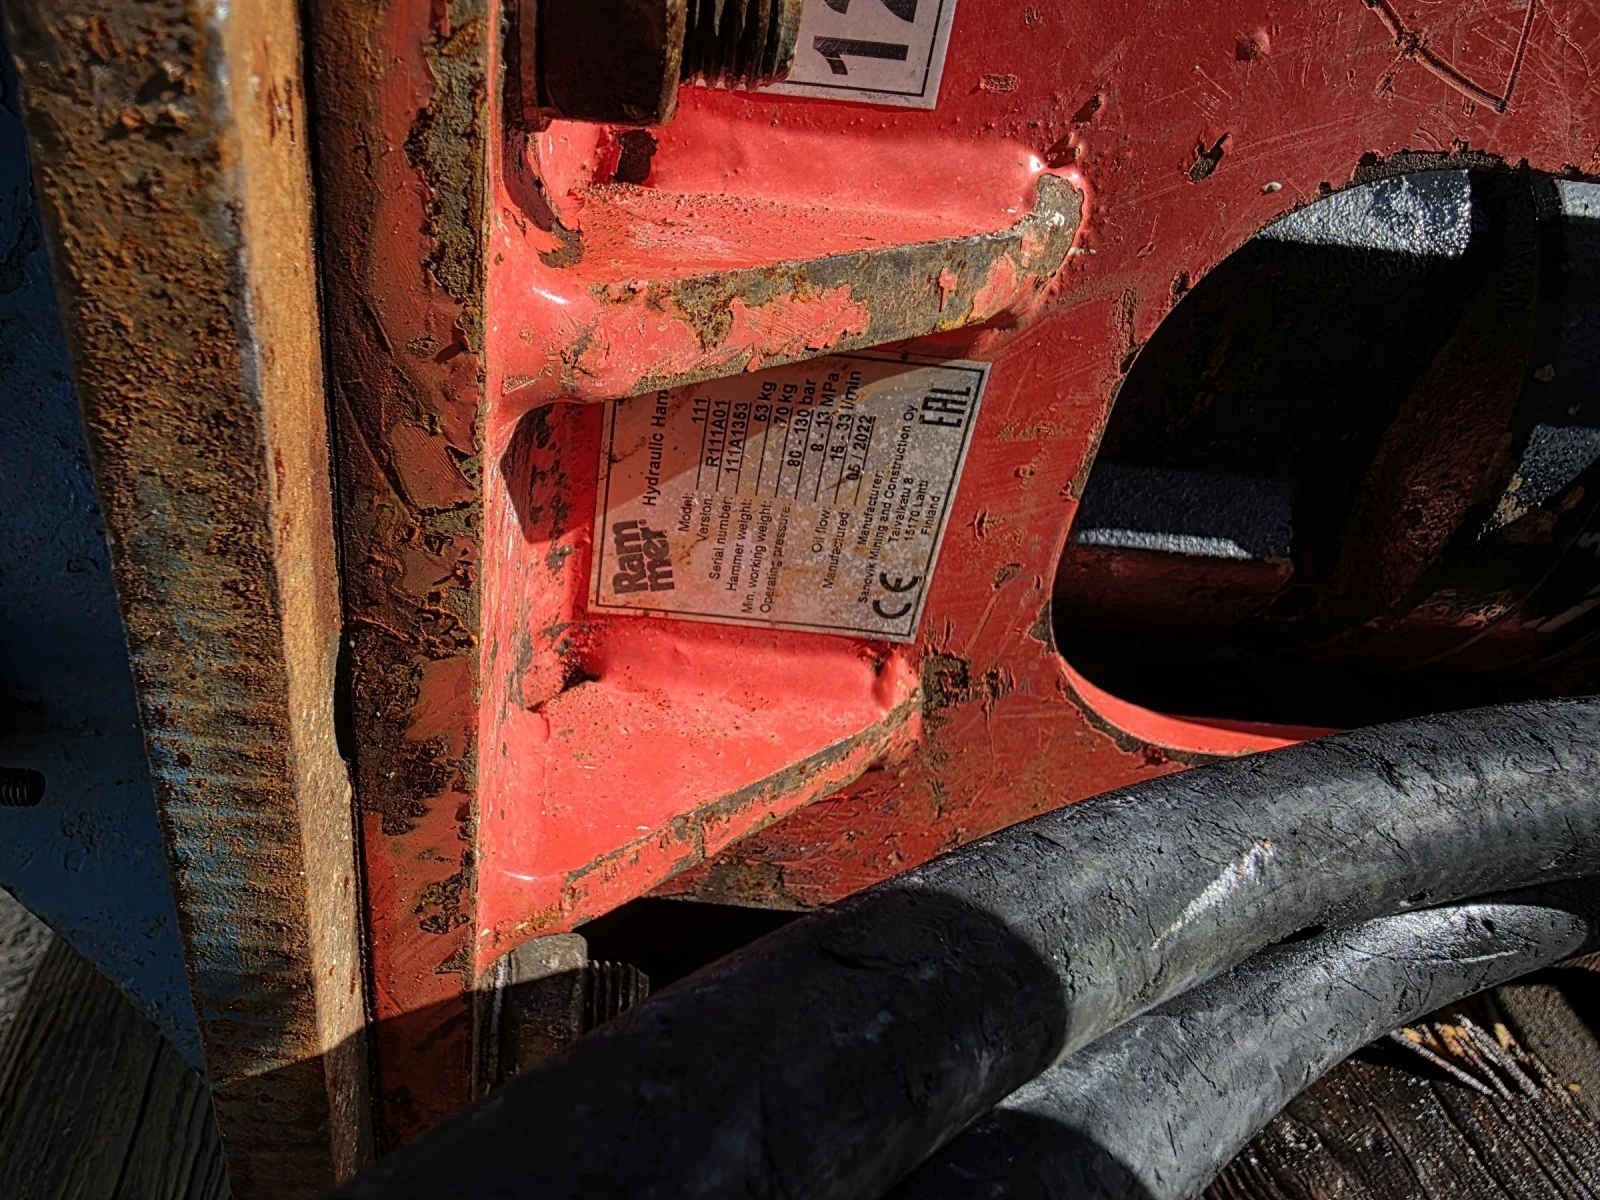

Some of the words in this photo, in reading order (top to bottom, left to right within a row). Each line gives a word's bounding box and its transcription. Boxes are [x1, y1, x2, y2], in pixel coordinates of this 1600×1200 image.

[778, 384, 797, 403] kg
[798, 379, 817, 405] bar
[820, 372, 840, 407] MPa
[840, 371, 862, 410] l/min
[774, 407, 789, 424] 70
[794, 409, 811, 434] 130
[816, 410, 830, 427] 13
[835, 413, 852, 431] 33
[903, 404, 918, 422] Oy
[725, 402, 749, 474] 111A1353
[810, 443, 824, 452] 8
[852, 415, 873, 451] 2022
[642, 433, 664, 506] Hydraulic
[678, 492, 695, 532] Model:
[691, 398, 707, 424] 111
[696, 493, 714, 541] Version:
[705, 400, 728, 467] R111A01
[787, 450, 802, 467] 80
[829, 445, 845, 461] 15
[884, 425, 911, 498] Construction
[726, 543, 744, 591] Hammer
[737, 498, 752, 540] weight:
[757, 382, 777, 401] kg
[845, 464, 862, 481] 05
[718, 496, 733, 545] number:
[757, 499, 773, 542] weight:
[815, 507, 832, 534] flow:
[857, 470, 885, 546] Manufacturer:
[880, 502, 892, 523] and
[888, 488, 912, 543] Taivalkatu
[904, 510, 920, 541] 15170
[913, 480, 929, 507] Lahti
[921, 496, 940, 535] Finland
[611, 520, 649, 595] Ram
[811, 535, 825, 553] Oil
[822, 508, 851, 589] Manufactured:
[869, 525, 888, 560] Mining
[709, 547, 724, 580] Serial
[749, 550, 766, 588] working
[760, 561, 782, 613] Operating
[858, 561, 876, 603] Sandvik
[741, 591, 755, 613] Min.
